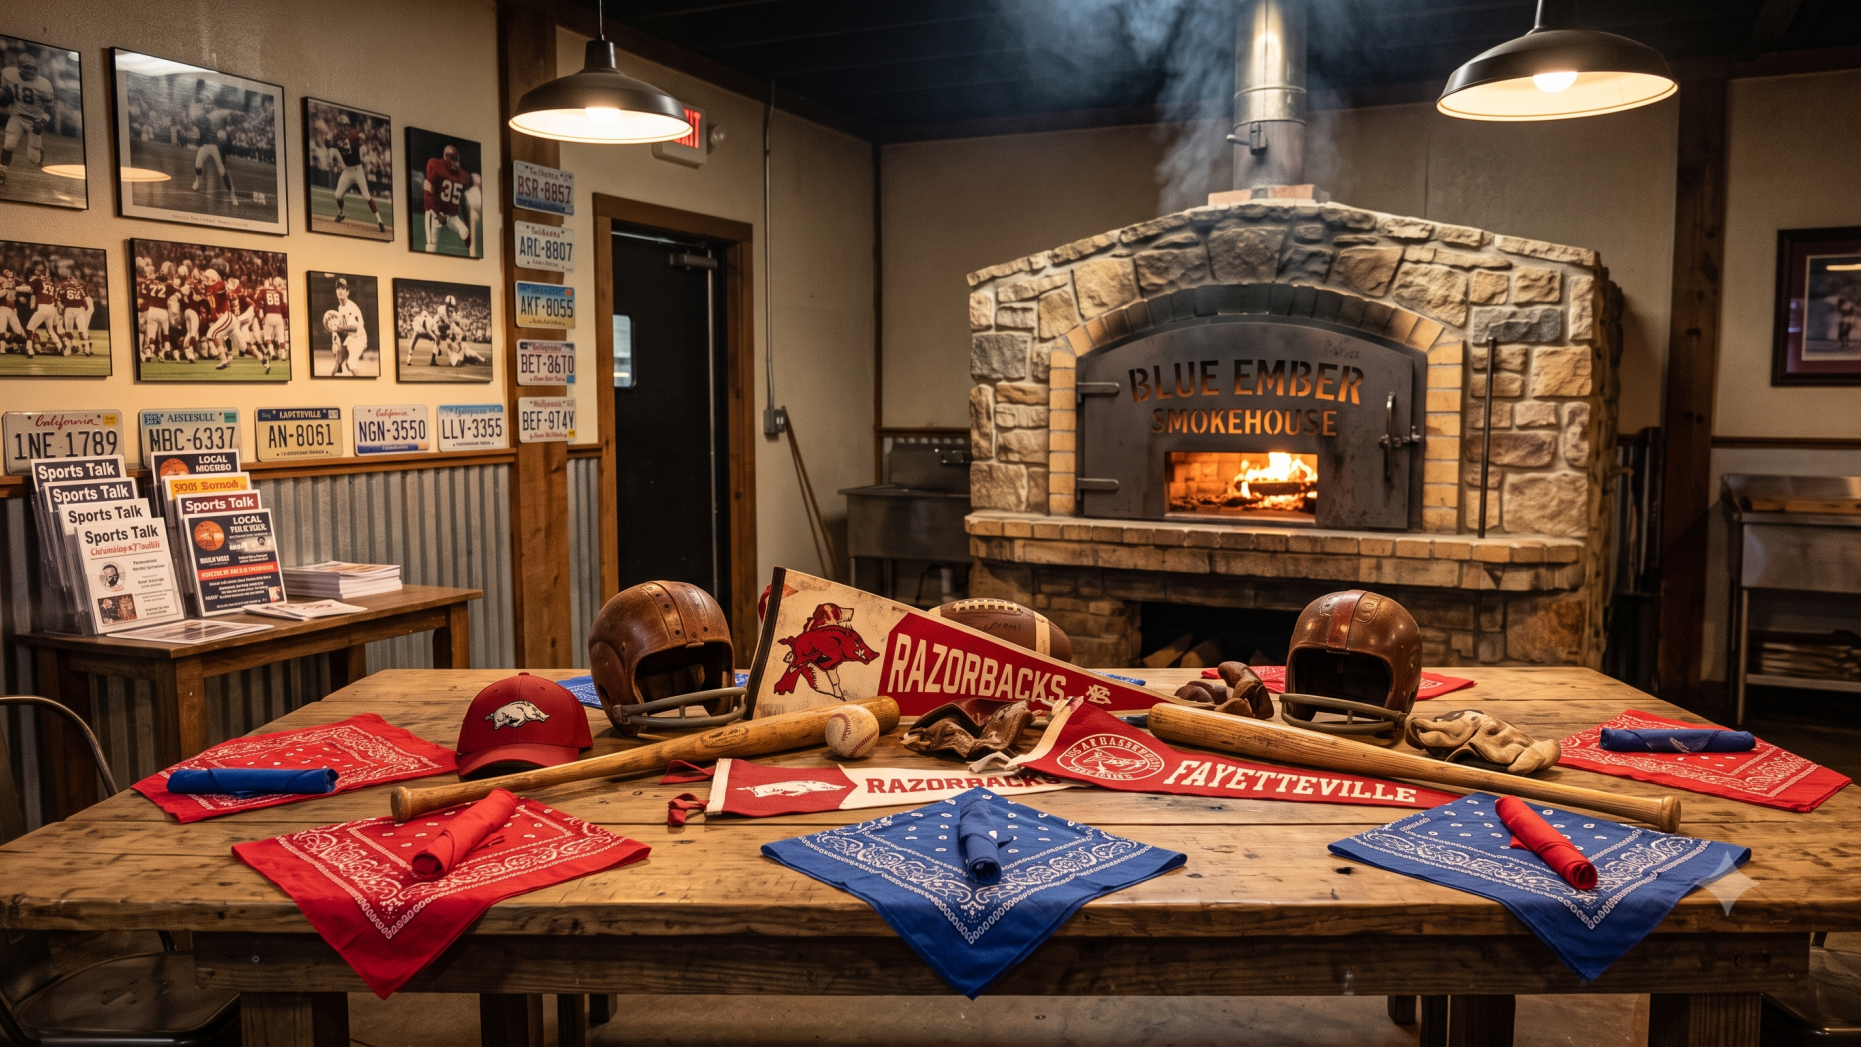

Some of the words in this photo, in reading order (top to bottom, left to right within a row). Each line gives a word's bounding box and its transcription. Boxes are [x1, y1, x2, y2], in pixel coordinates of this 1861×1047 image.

[440, 179, 463, 205] 35
[1128, 359, 1220, 404] BLUE
[1233, 359, 1365, 405] EMBER
[35, 414, 99, 430] California
[359, 419, 426, 442] NGN-3550
[1151, 408, 1338, 437] SMOKEHOUSE
[268, 423, 334, 449] AN-8061
[198, 455, 228, 464] LOCAL
[38, 464, 84, 482] Sports
[85, 462, 116, 477] Talk
[52, 487, 98, 505] Sports
[100, 484, 130, 499] Talk
[68, 509, 113, 525] Sports
[114, 505, 143, 519] Talk
[185, 498, 226, 514] Sports
[228, 497, 255, 509] Talk
[232, 515, 262, 525] LOCAL
[84, 529, 129, 546] Sports
[130, 524, 159, 539] Talk
[887, 632, 1067, 705] RAZORBACKS
[866, 774, 1062, 794] RAZORBACKS
[1163, 759, 1417, 804] FAYETTEVILLE
